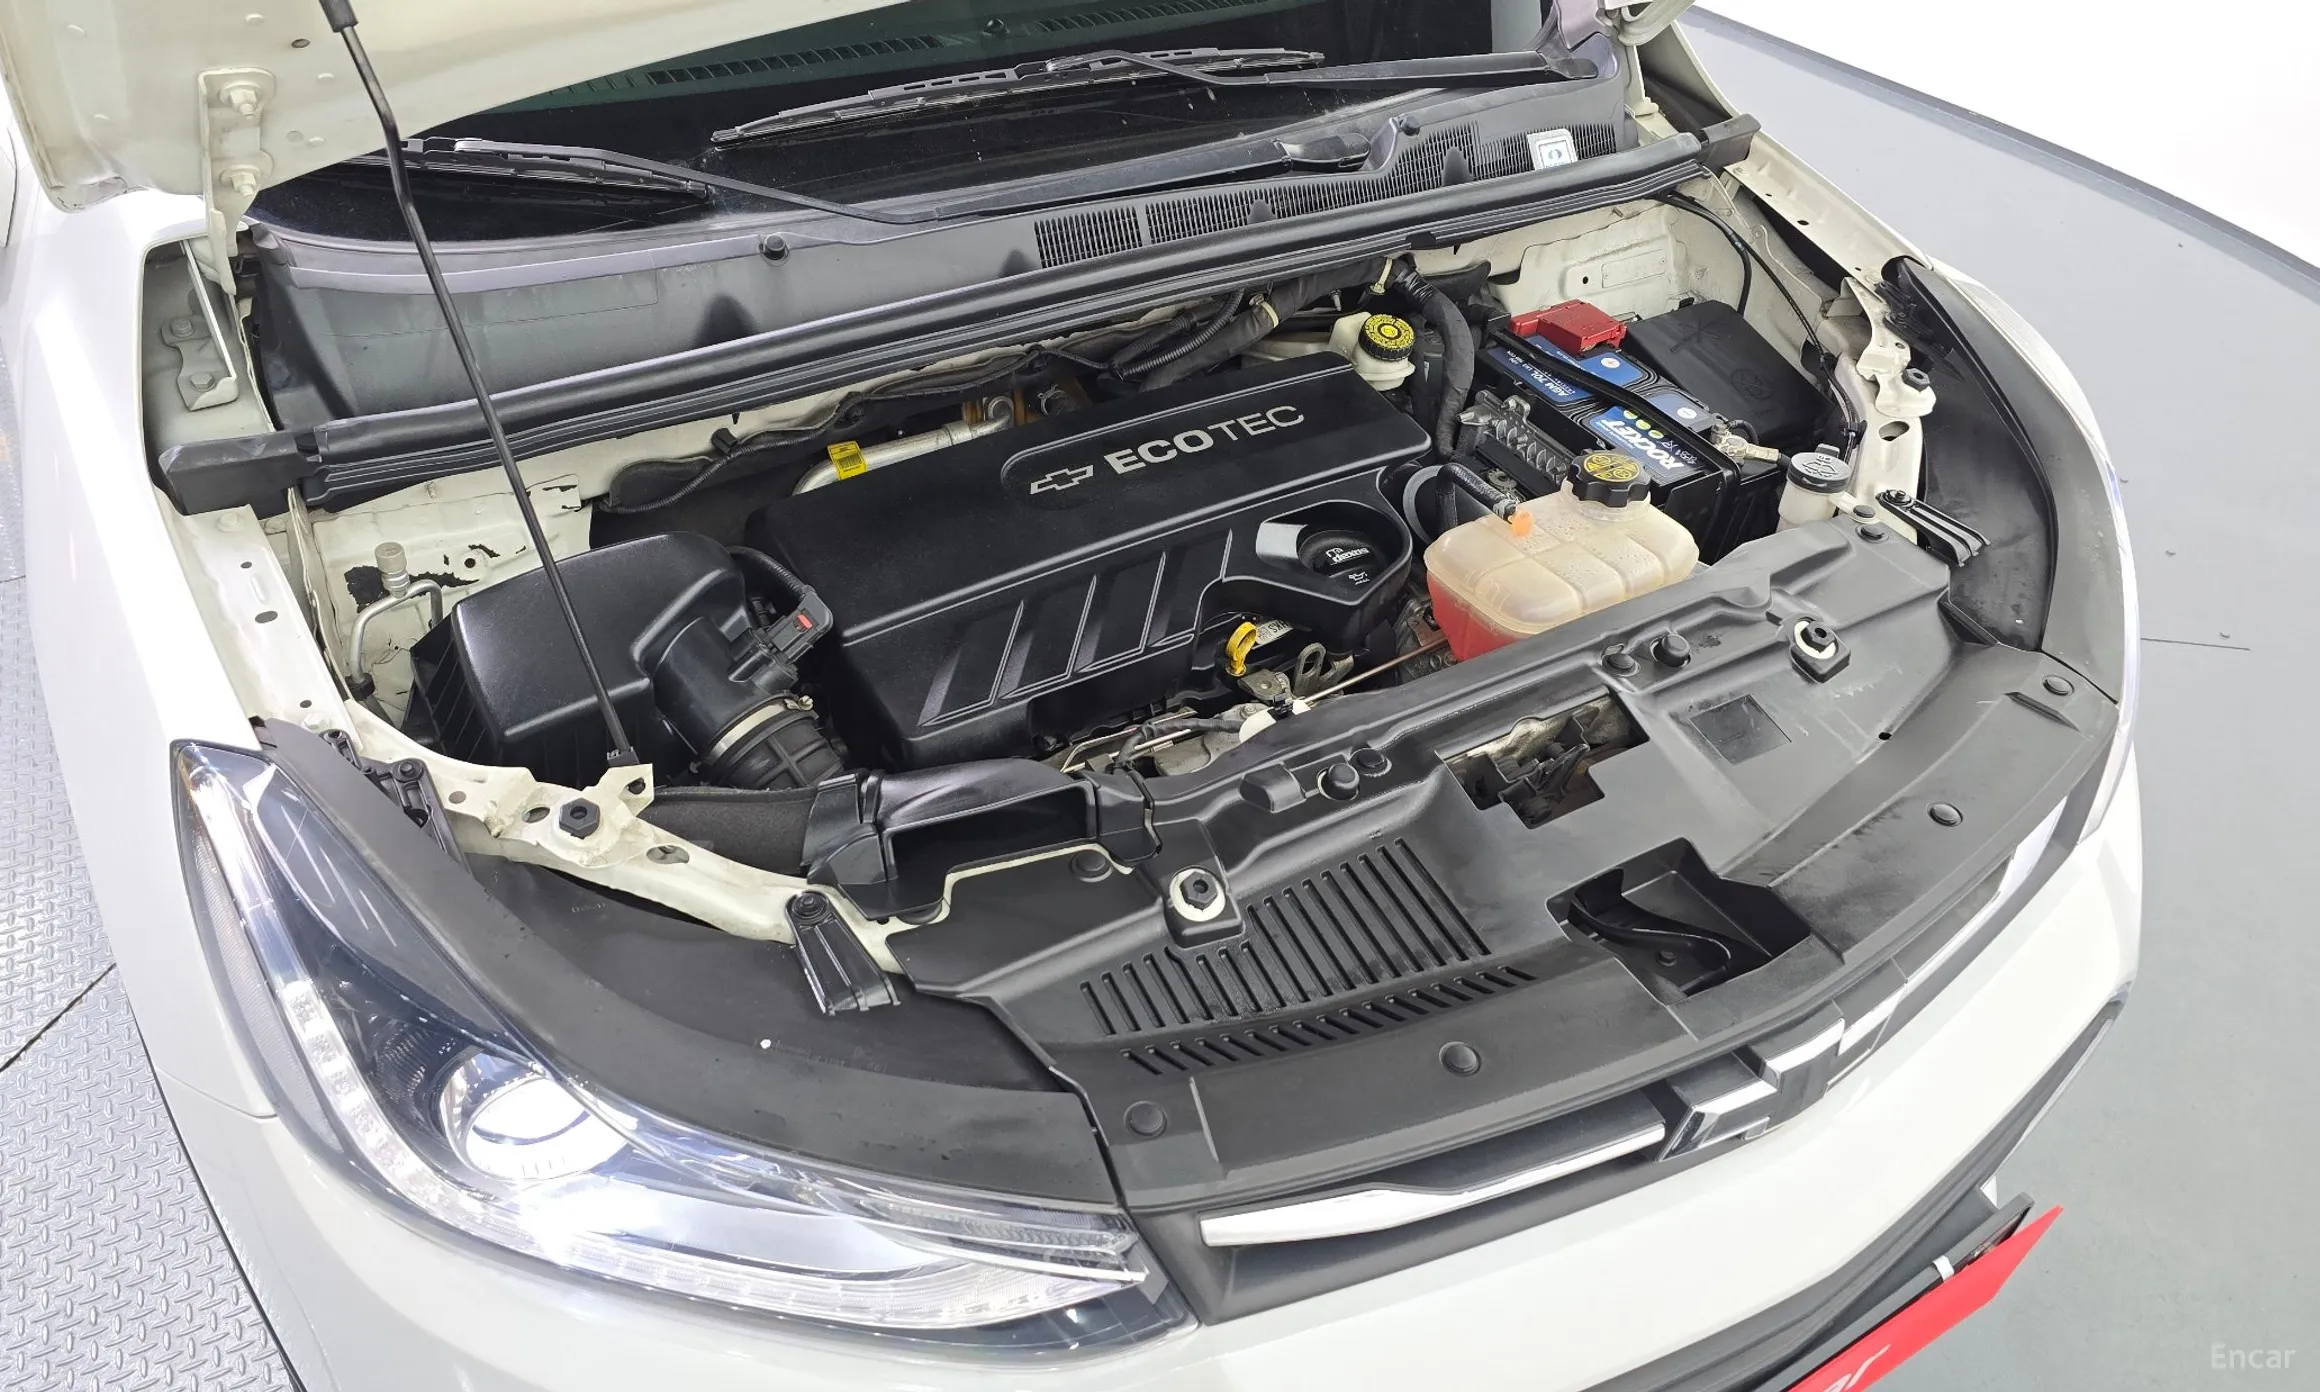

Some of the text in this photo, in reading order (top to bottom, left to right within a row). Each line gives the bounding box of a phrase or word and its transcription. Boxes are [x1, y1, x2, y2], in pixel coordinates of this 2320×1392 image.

[1545, 382, 1569, 396] AGM
[1104, 405, 1304, 475] ECOTEC
[1601, 419, 1685, 470] ROCKET
